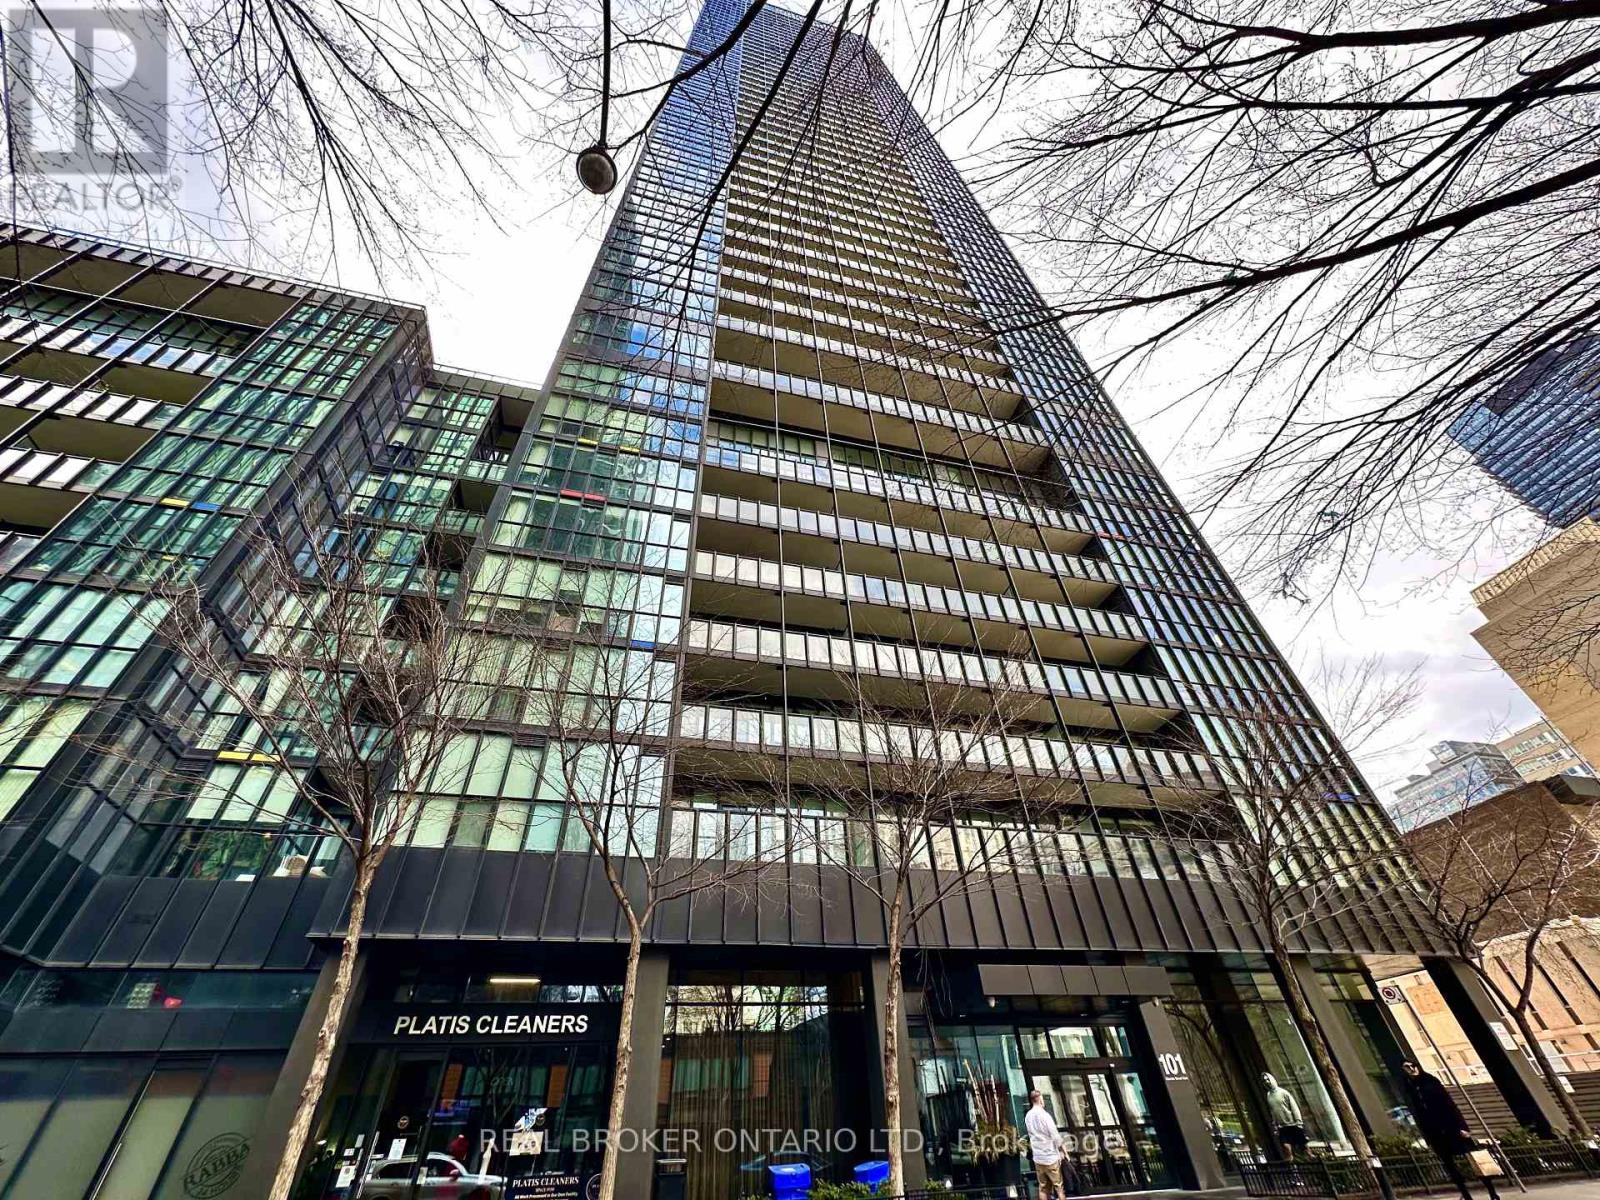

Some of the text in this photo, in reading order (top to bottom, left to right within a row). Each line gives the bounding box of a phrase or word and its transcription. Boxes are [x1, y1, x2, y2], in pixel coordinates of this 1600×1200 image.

[393, 1015, 589, 1035] PLATIS CLEANERS
[1158, 1052, 1187, 1076] 101
[183, 1143, 250, 1194] RABBA
[512, 1177, 579, 1188] PLATIS CLEANERS
